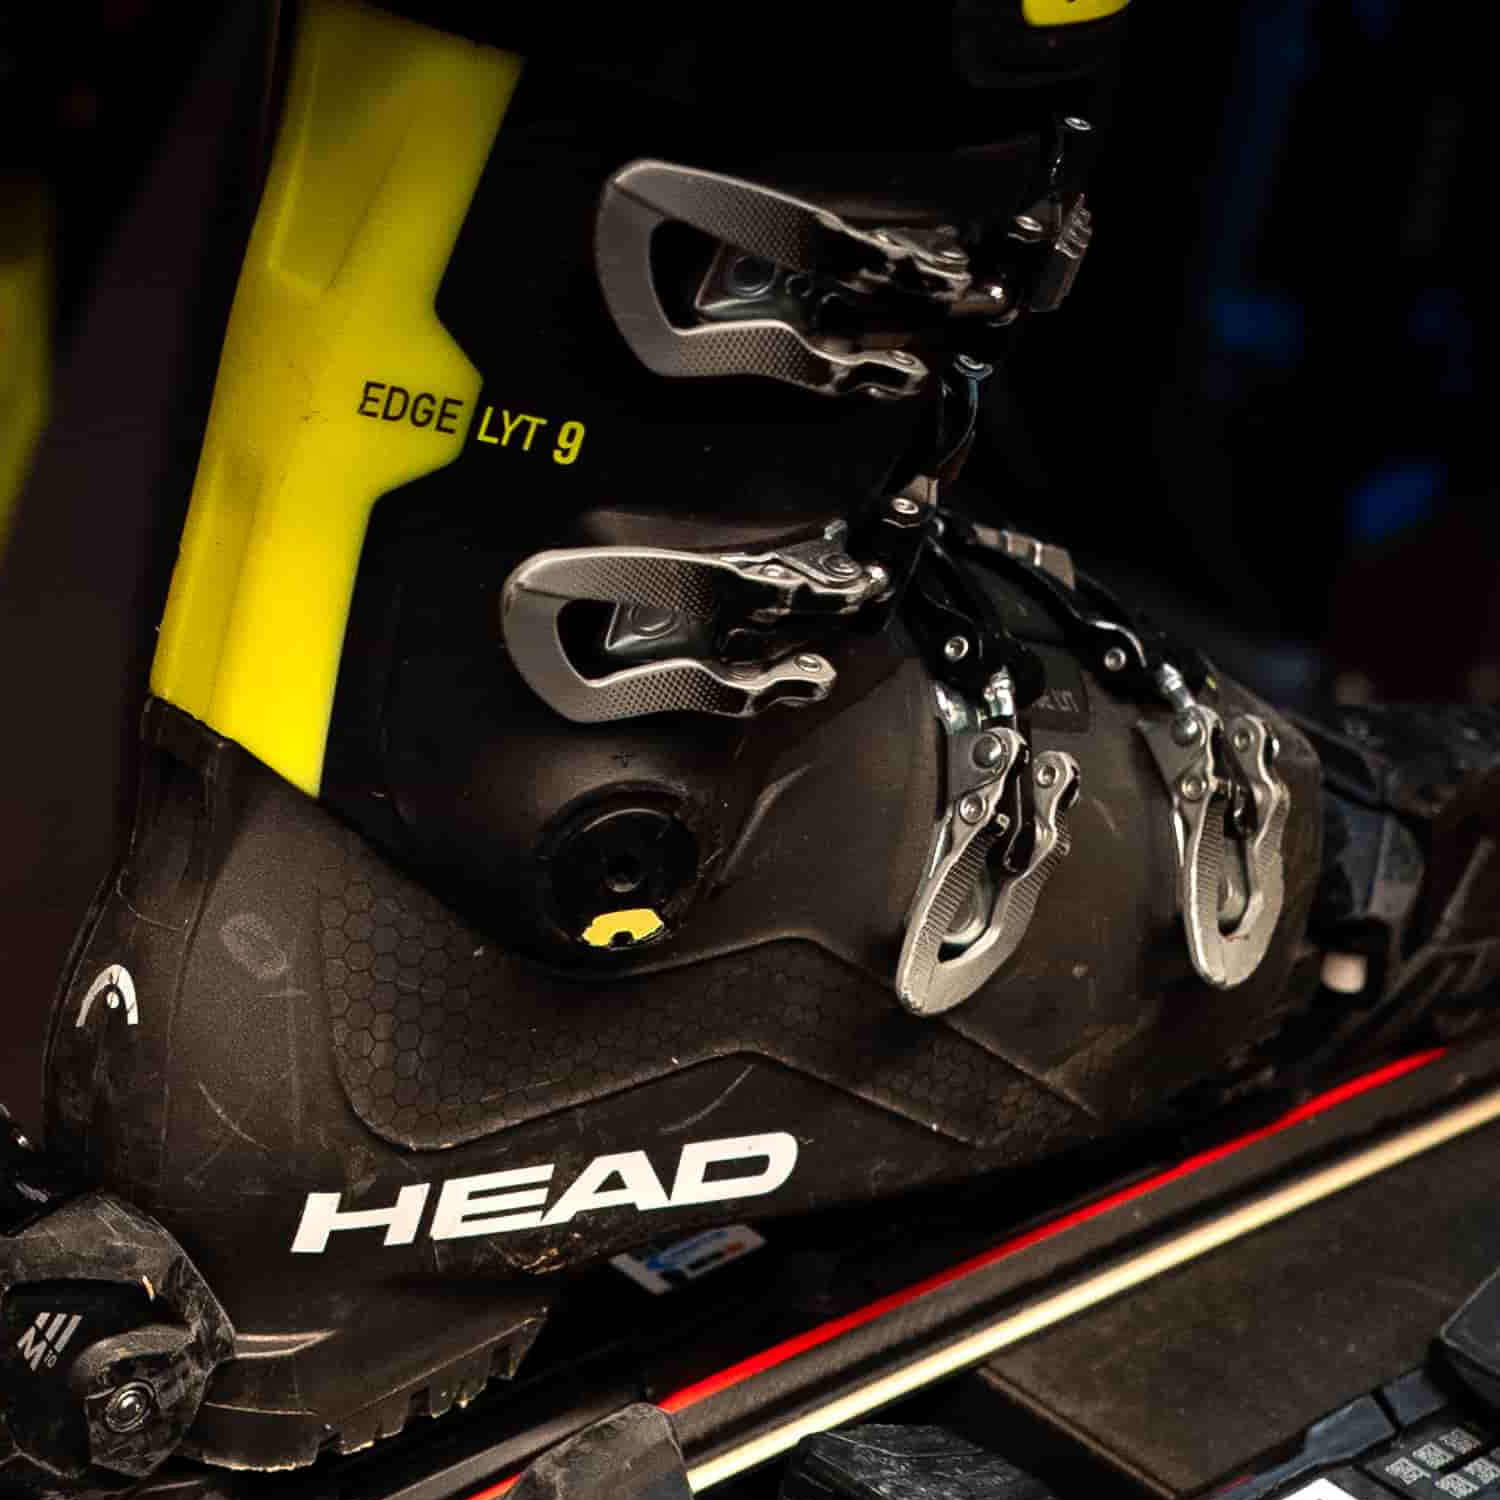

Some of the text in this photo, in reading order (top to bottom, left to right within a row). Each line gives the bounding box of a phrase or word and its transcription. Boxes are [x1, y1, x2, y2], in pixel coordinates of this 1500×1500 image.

[357, 380, 584, 464] EDGE LYT 9
[291, 1132, 797, 1252] HEAD
